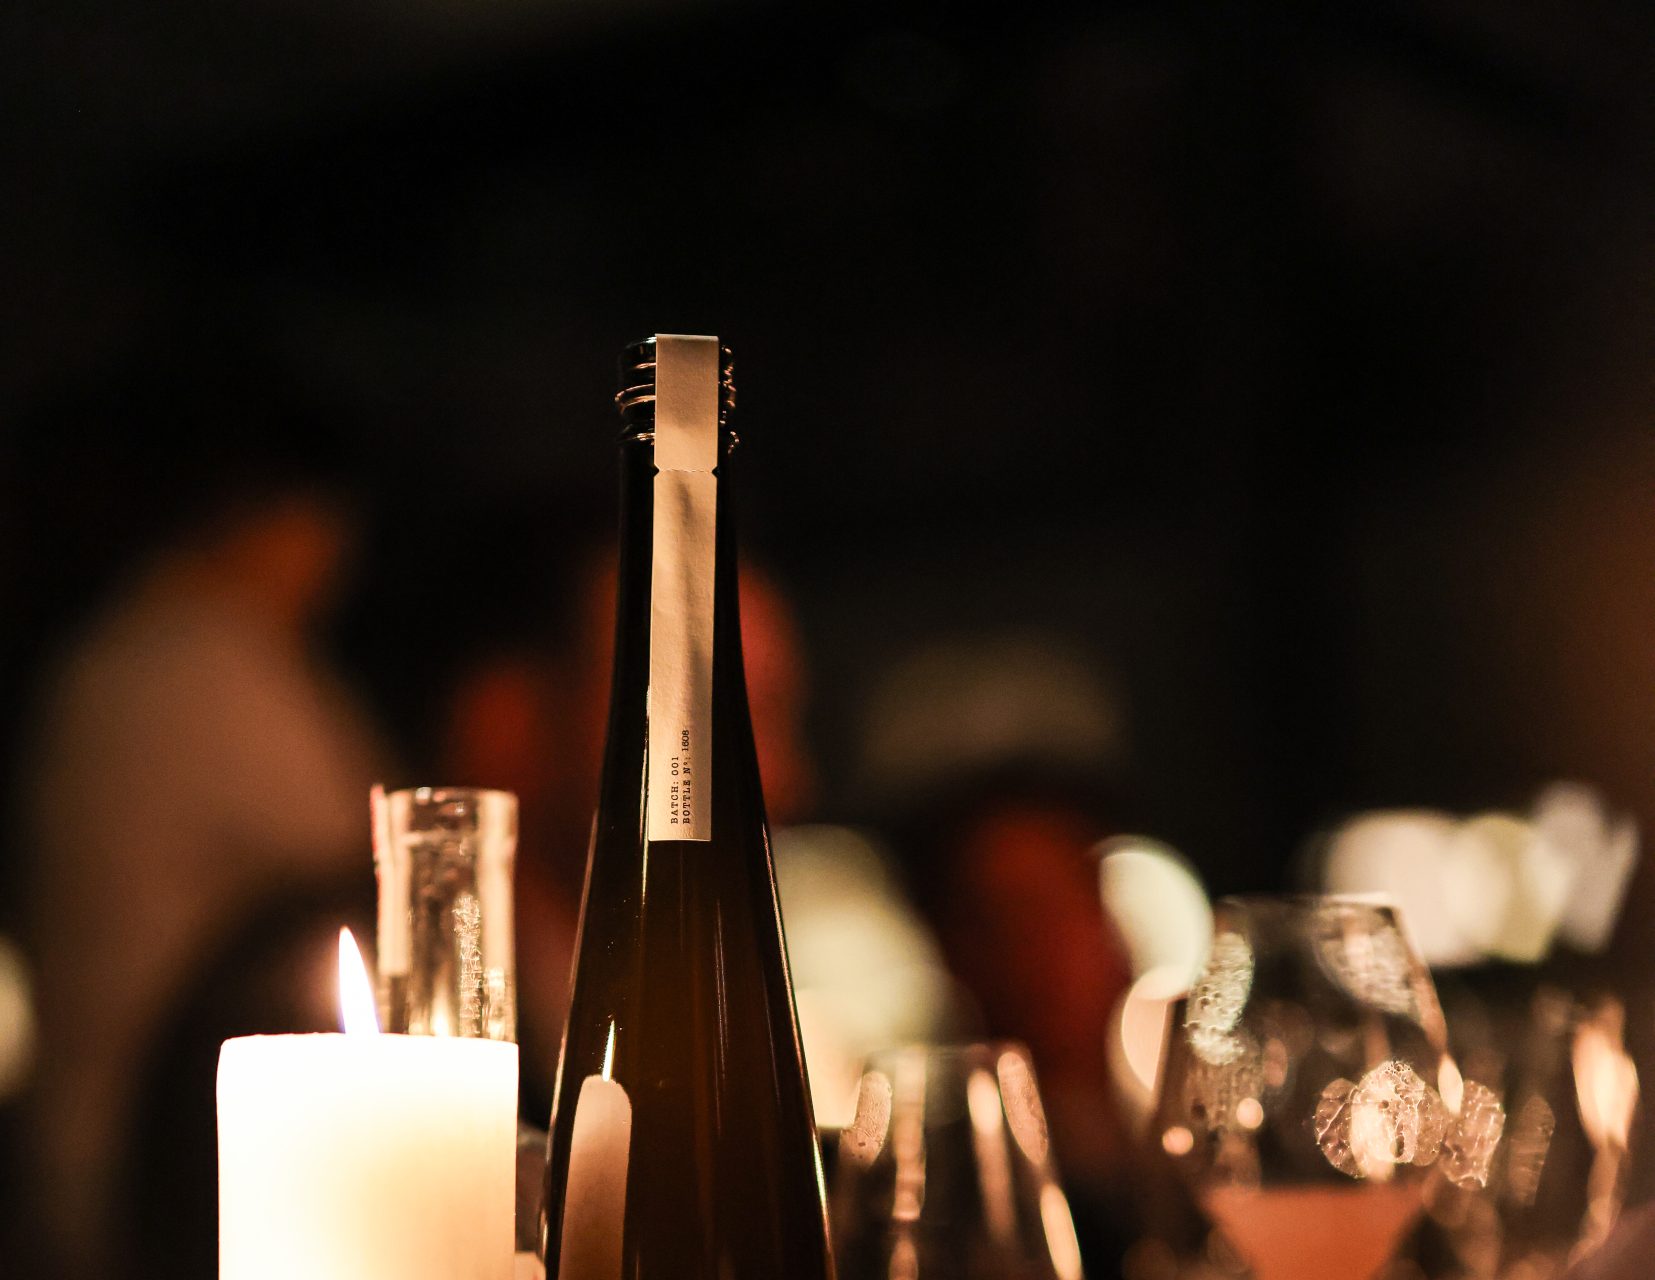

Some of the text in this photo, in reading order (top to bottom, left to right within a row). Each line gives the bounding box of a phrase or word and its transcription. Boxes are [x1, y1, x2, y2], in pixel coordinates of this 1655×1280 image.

[682, 729, 690, 751] 1608
[670, 781, 679, 824] BATCH:
[683, 780, 691, 824] BOTTLE
